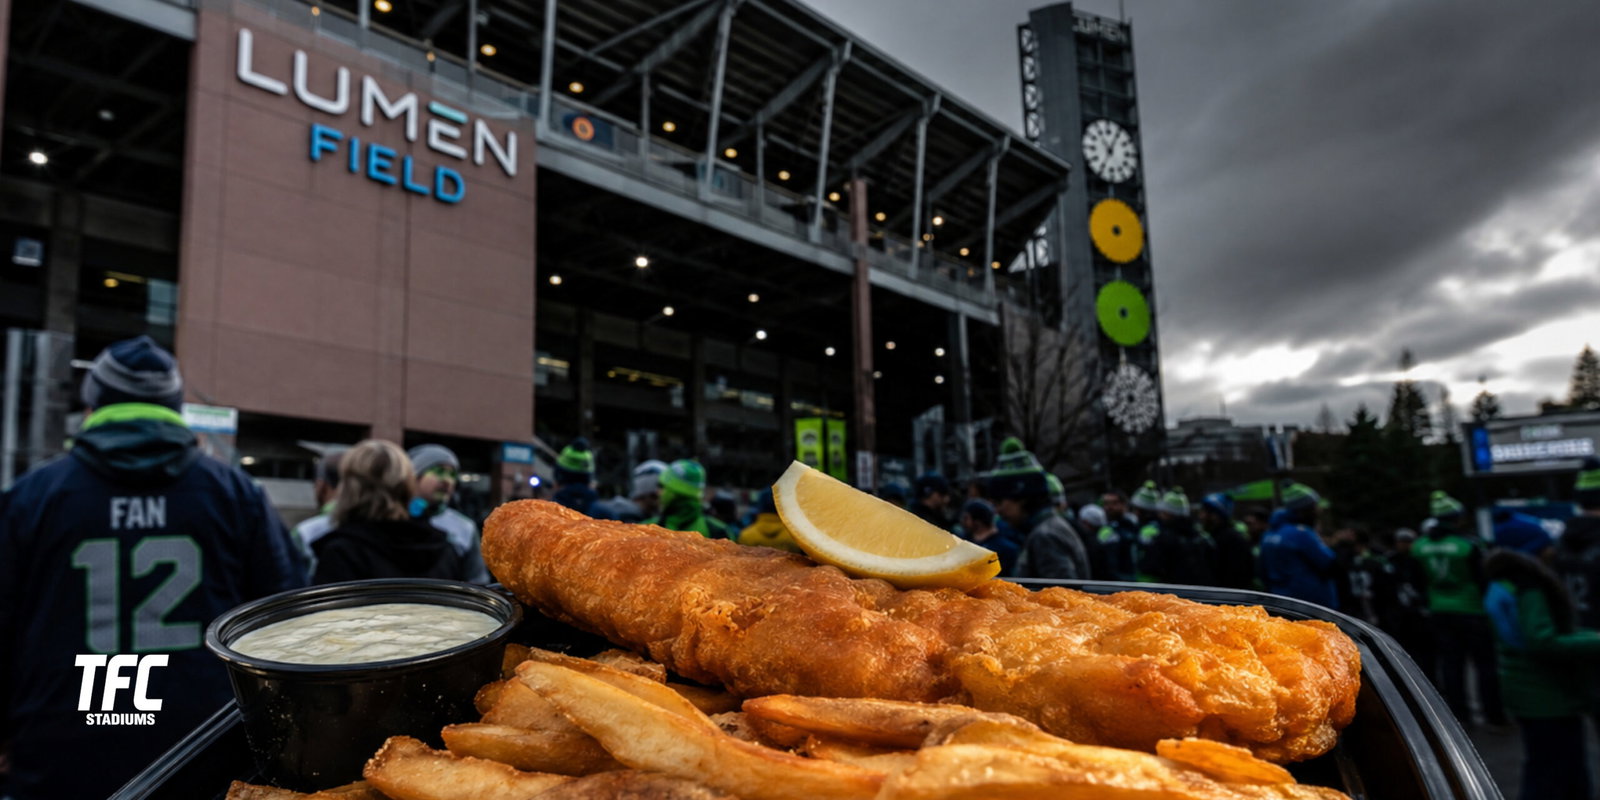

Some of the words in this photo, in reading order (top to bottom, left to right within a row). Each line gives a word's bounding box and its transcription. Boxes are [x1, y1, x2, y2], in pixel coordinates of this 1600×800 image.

[237, 28, 518, 177] LUMEN
[309, 123, 466, 204] FIELD
[110, 496, 166, 529] FAN
[72, 536, 202, 654] 12
